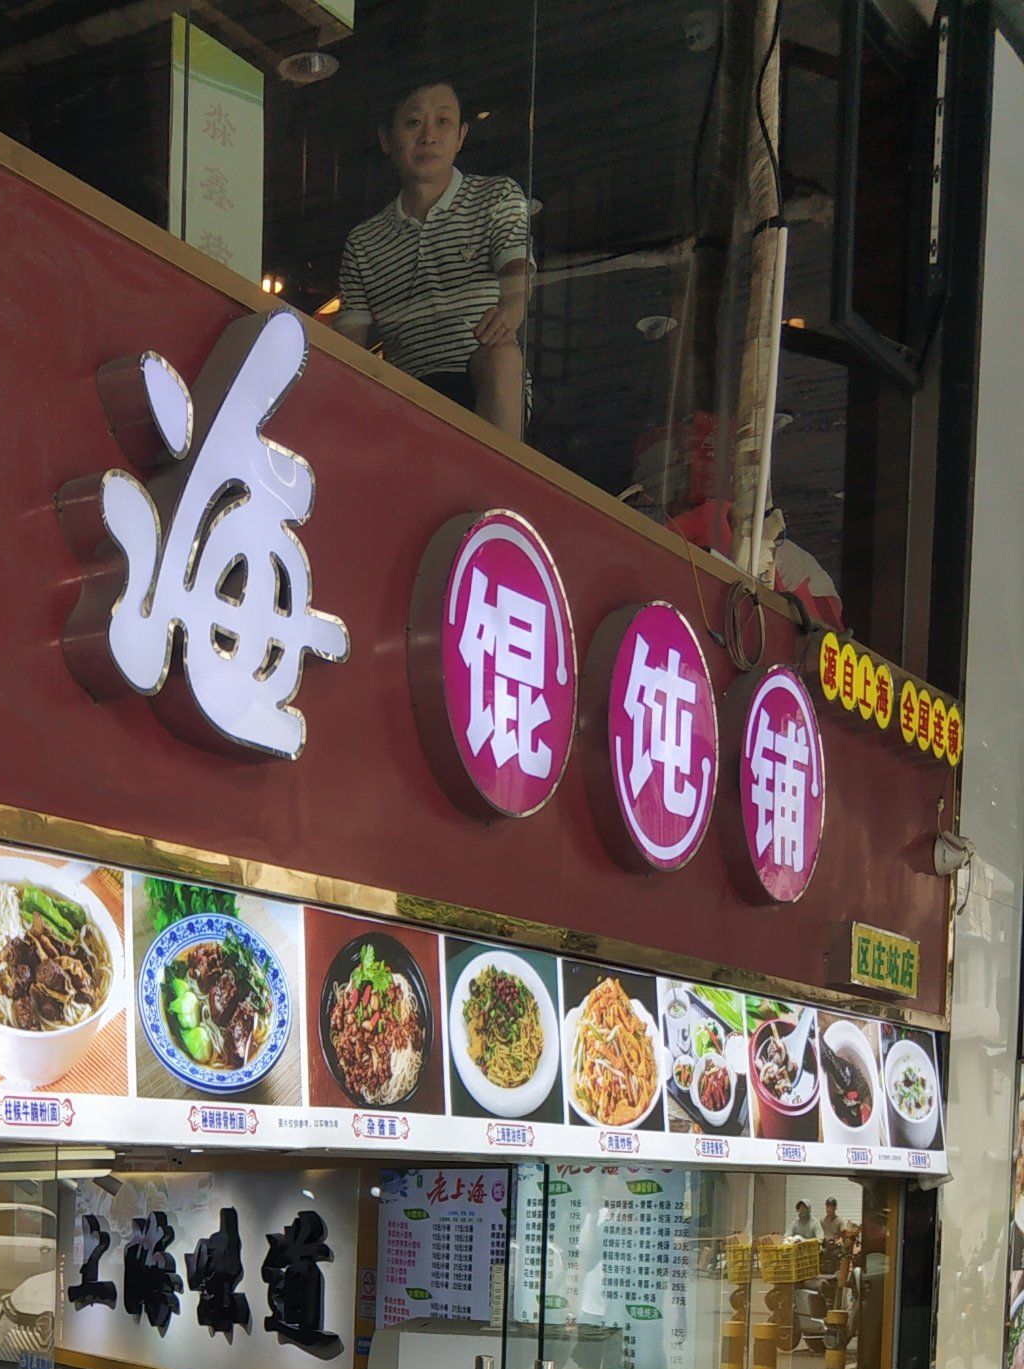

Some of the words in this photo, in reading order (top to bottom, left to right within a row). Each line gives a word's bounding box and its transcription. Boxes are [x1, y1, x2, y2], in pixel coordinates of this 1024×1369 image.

[823, 645, 889, 720] 源自上海
[902, 693, 960, 760] 全国连锁
[857, 937, 914, 988] 区庄站店
[367, 1118, 397, 1137] 杂酱面
[426, 1171, 488, 1206] 老上海
